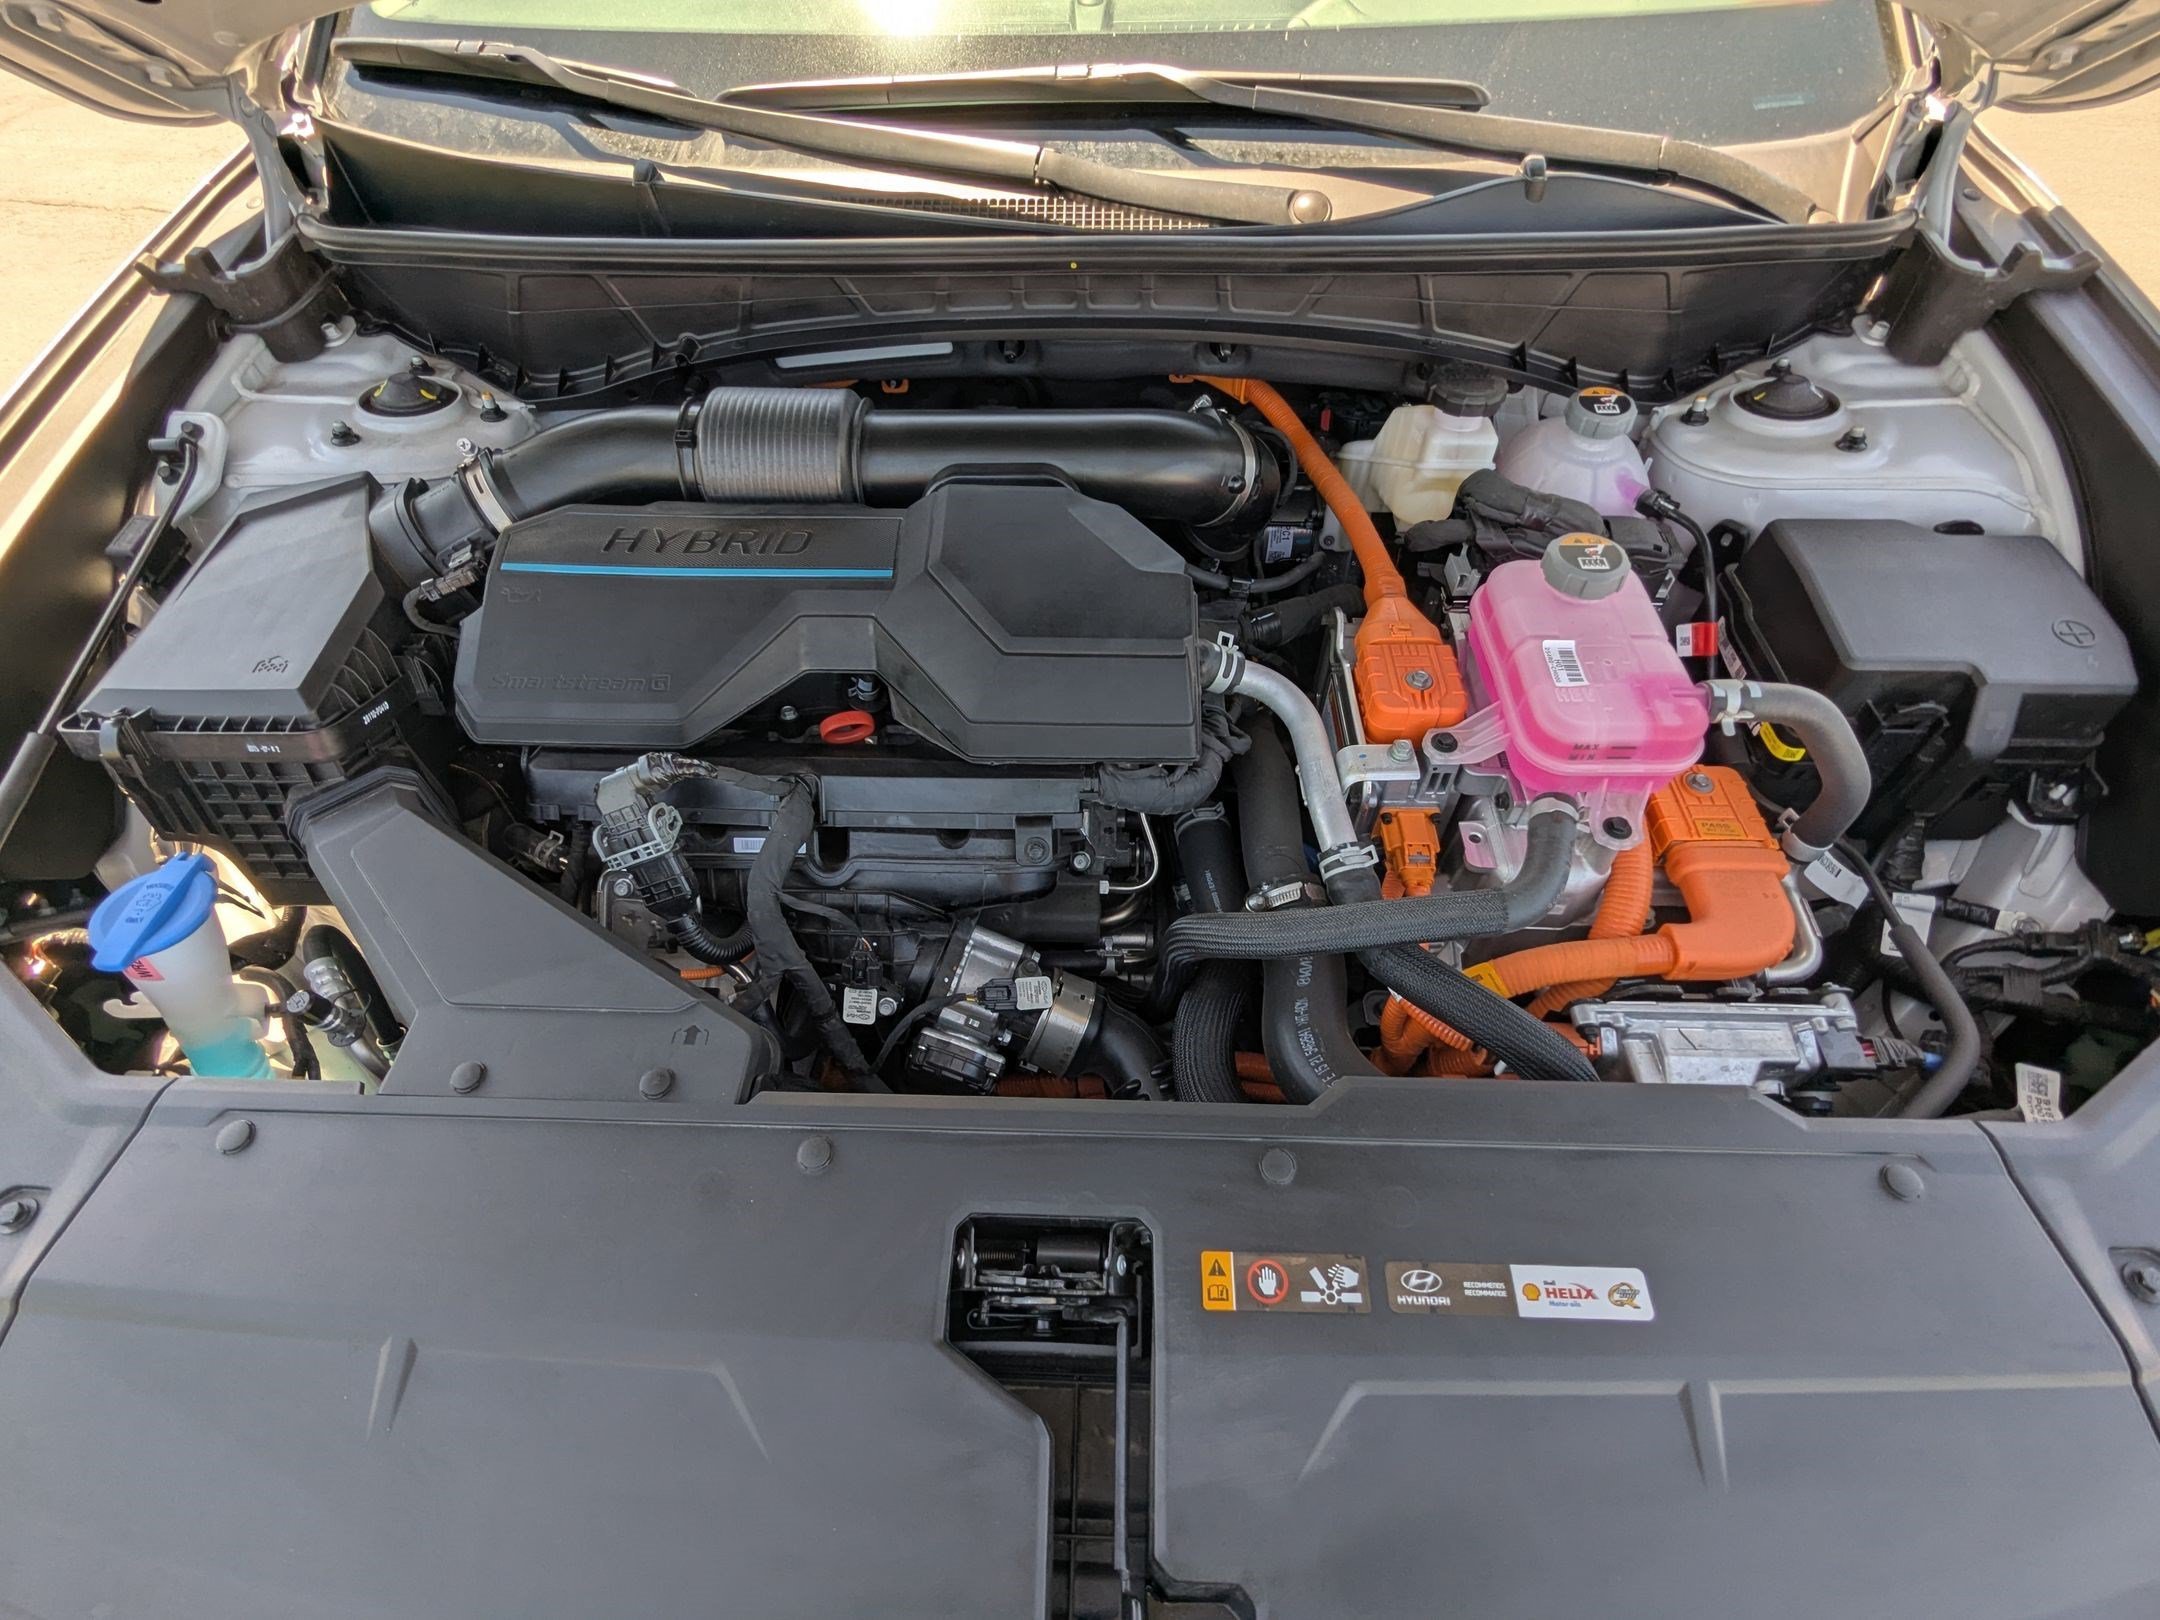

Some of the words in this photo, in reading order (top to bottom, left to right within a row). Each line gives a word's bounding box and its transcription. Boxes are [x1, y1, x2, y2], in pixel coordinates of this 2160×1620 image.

[601, 527, 814, 555] HYBRID
[488, 671, 646, 692] Smartstream
[1573, 743, 1600, 751] MAX
[1463, 1281, 1505, 1289] RECOMMENDS
[1544, 1286, 1599, 1300] HELIX
[1397, 1295, 1451, 1306] HYUNDAI
